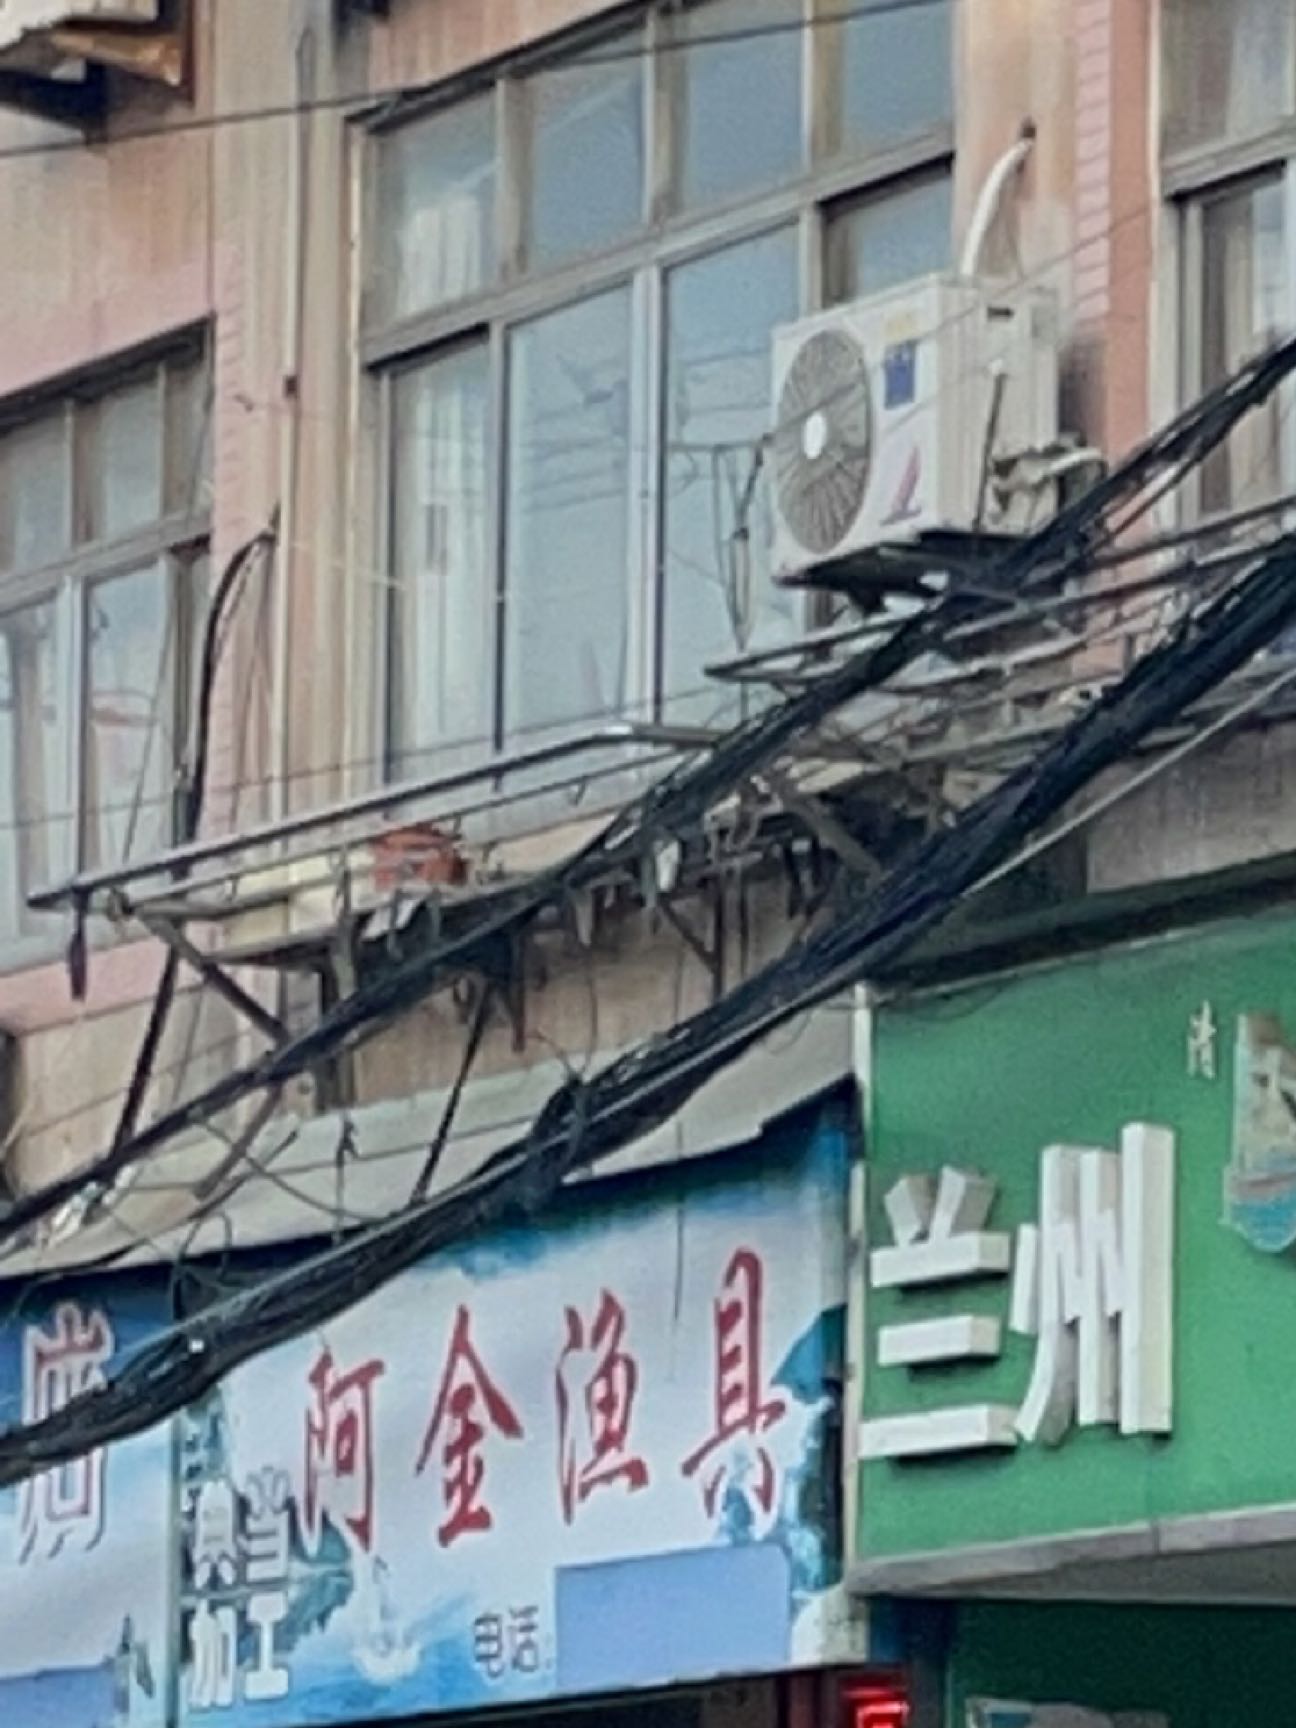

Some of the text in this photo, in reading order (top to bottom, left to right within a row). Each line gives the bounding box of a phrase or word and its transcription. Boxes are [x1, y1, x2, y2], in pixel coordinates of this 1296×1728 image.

[303, 1246, 787, 1552] 阿金渔具
[859, 1122, 1176, 1460] 兰州
[473, 1604, 541, 1679] 电话
